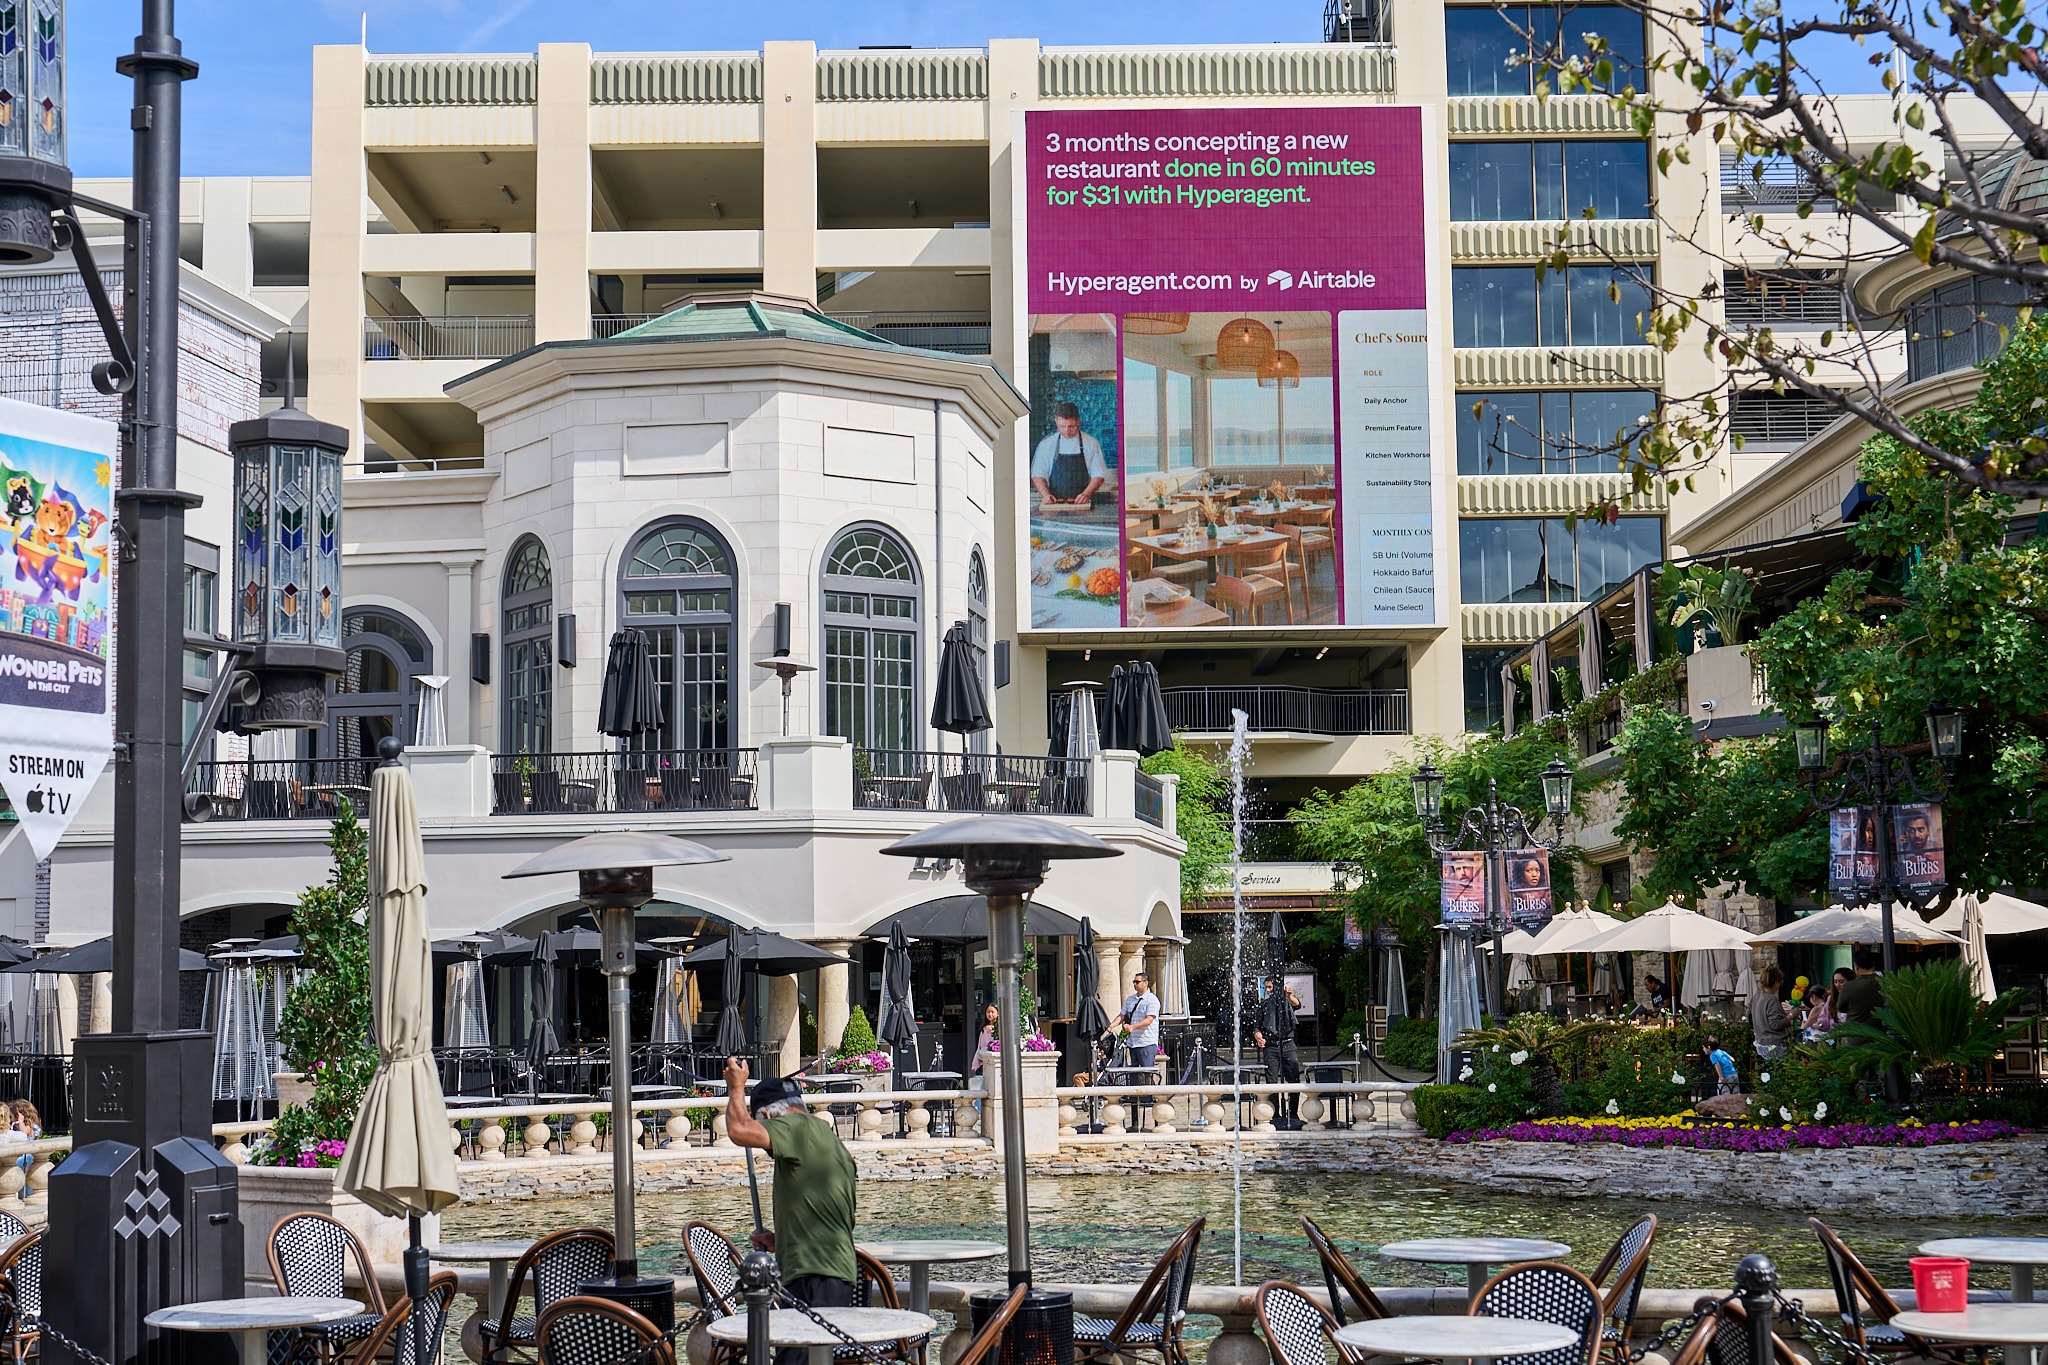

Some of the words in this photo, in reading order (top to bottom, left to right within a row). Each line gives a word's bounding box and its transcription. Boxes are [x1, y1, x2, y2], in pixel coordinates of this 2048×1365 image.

[1046, 132, 1060, 152] 3
[1065, 132, 1150, 152] months
[1154, 131, 1280, 154] concepting
[1284, 134, 1298, 149] a
[1302, 133, 1348, 149] new
[1046, 160, 1160, 179] restaurant
[1164, 157, 1221, 177] done
[1226, 157, 1245, 176] in
[1250, 157, 1281, 176] 60
[1286, 156, 1376, 176] minutes
[1046, 185, 1078, 205] for
[1082, 183, 1120, 207] $31
[1124, 184, 1171, 204] with
[1176, 184, 1312, 208] Hyperagent.
[1047, 271, 1232, 295] Hyperagent.com
[1240, 274, 1259, 292] by
[1298, 269, 1376, 289] Airtable
[1355, 332, 1393, 344] Chef's
[1364, 397, 1381, 405] Daily
[1366, 479, 1412, 487] Sustainability
[1413, 479, 1431, 487] Story
[1372, 529, 1413, 537] MONTHLY
[1414, 528, 1432, 537] COS
[1372, 551, 1384, 559] SB
[1385, 551, 1399, 559] Uni
[1401, 551, 1433, 560] (Volume
[1373, 569, 1410, 577] Hokkaido
[1373, 586, 1403, 594] Chilean
[1397, 603, 1424, 612] (Select)
[0, 654, 67, 682] WONDER
[68, 660, 102, 686] PETS
[27, 680, 36, 690] IN
[37, 681, 52, 692] THE
[53, 683, 71, 694] CITY
[9, 754, 64, 777] STREAM
[66, 759, 84, 779] ON
[47, 787, 71, 815] tv
[1241, 872, 1281, 886] Services
